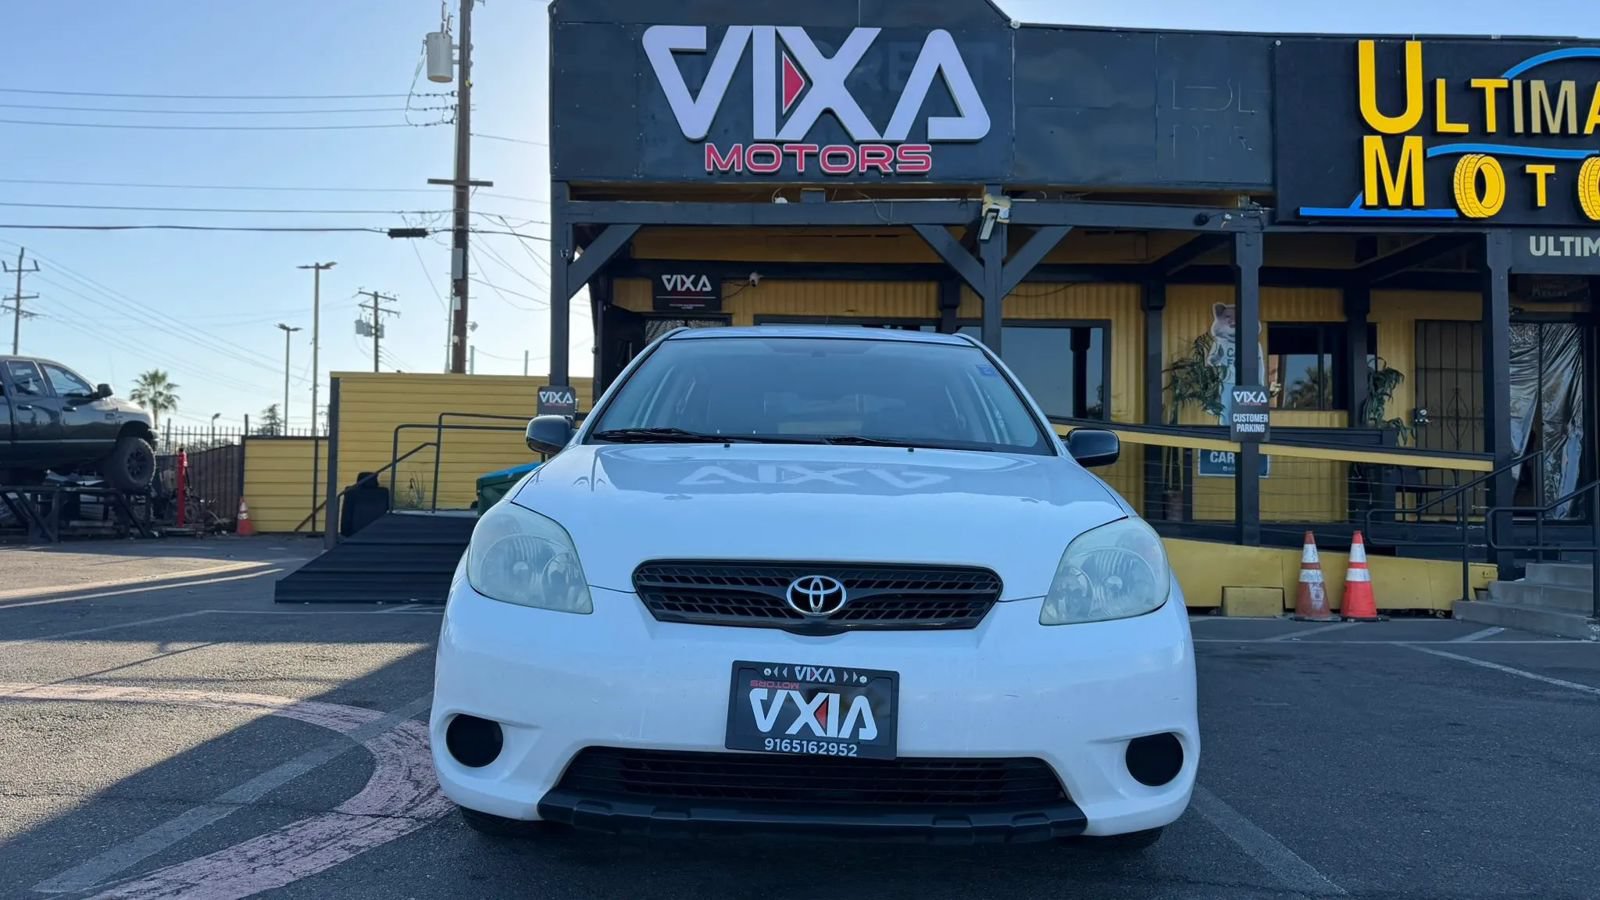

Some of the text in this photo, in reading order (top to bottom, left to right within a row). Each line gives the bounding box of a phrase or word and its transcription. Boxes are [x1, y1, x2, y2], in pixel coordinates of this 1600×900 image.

[642, 25, 991, 142] VIXA
[704, 143, 932, 174] MOTORS
[661, 274, 712, 292] VIXA
[539, 391, 573, 404] VIXA
[1233, 391, 1267, 403] VIXA
[1232, 413, 1269, 423] CUSTOMER
[1236, 423, 1265, 433] PARKING
[1209, 451, 1235, 464] CAR
[795, 666, 836, 683] VIXA
[764, 738, 858, 757] 9165162952
